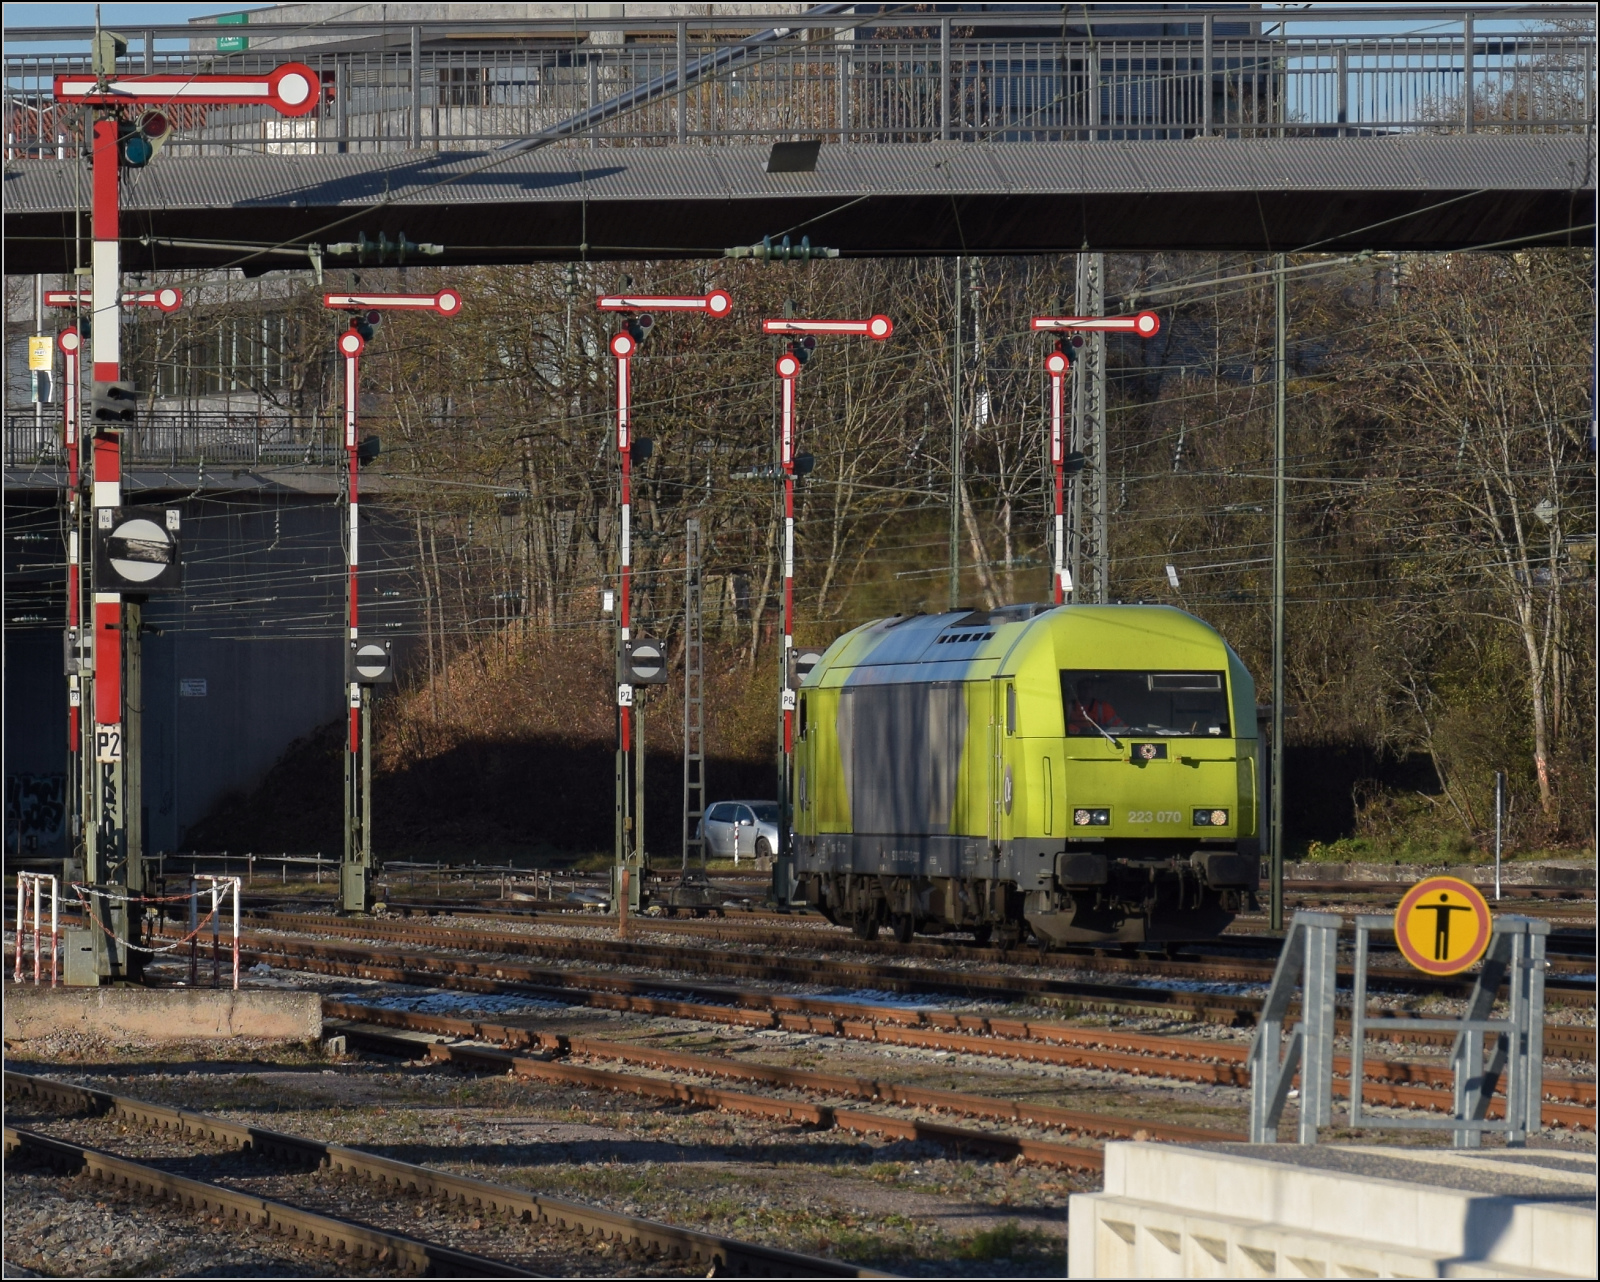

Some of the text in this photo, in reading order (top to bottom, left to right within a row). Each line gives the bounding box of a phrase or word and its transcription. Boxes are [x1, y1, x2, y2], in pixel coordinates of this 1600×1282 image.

[784, 696, 793, 704] P8
[97, 732, 120, 757] P2
[1128, 811, 1182, 823] 223 070
